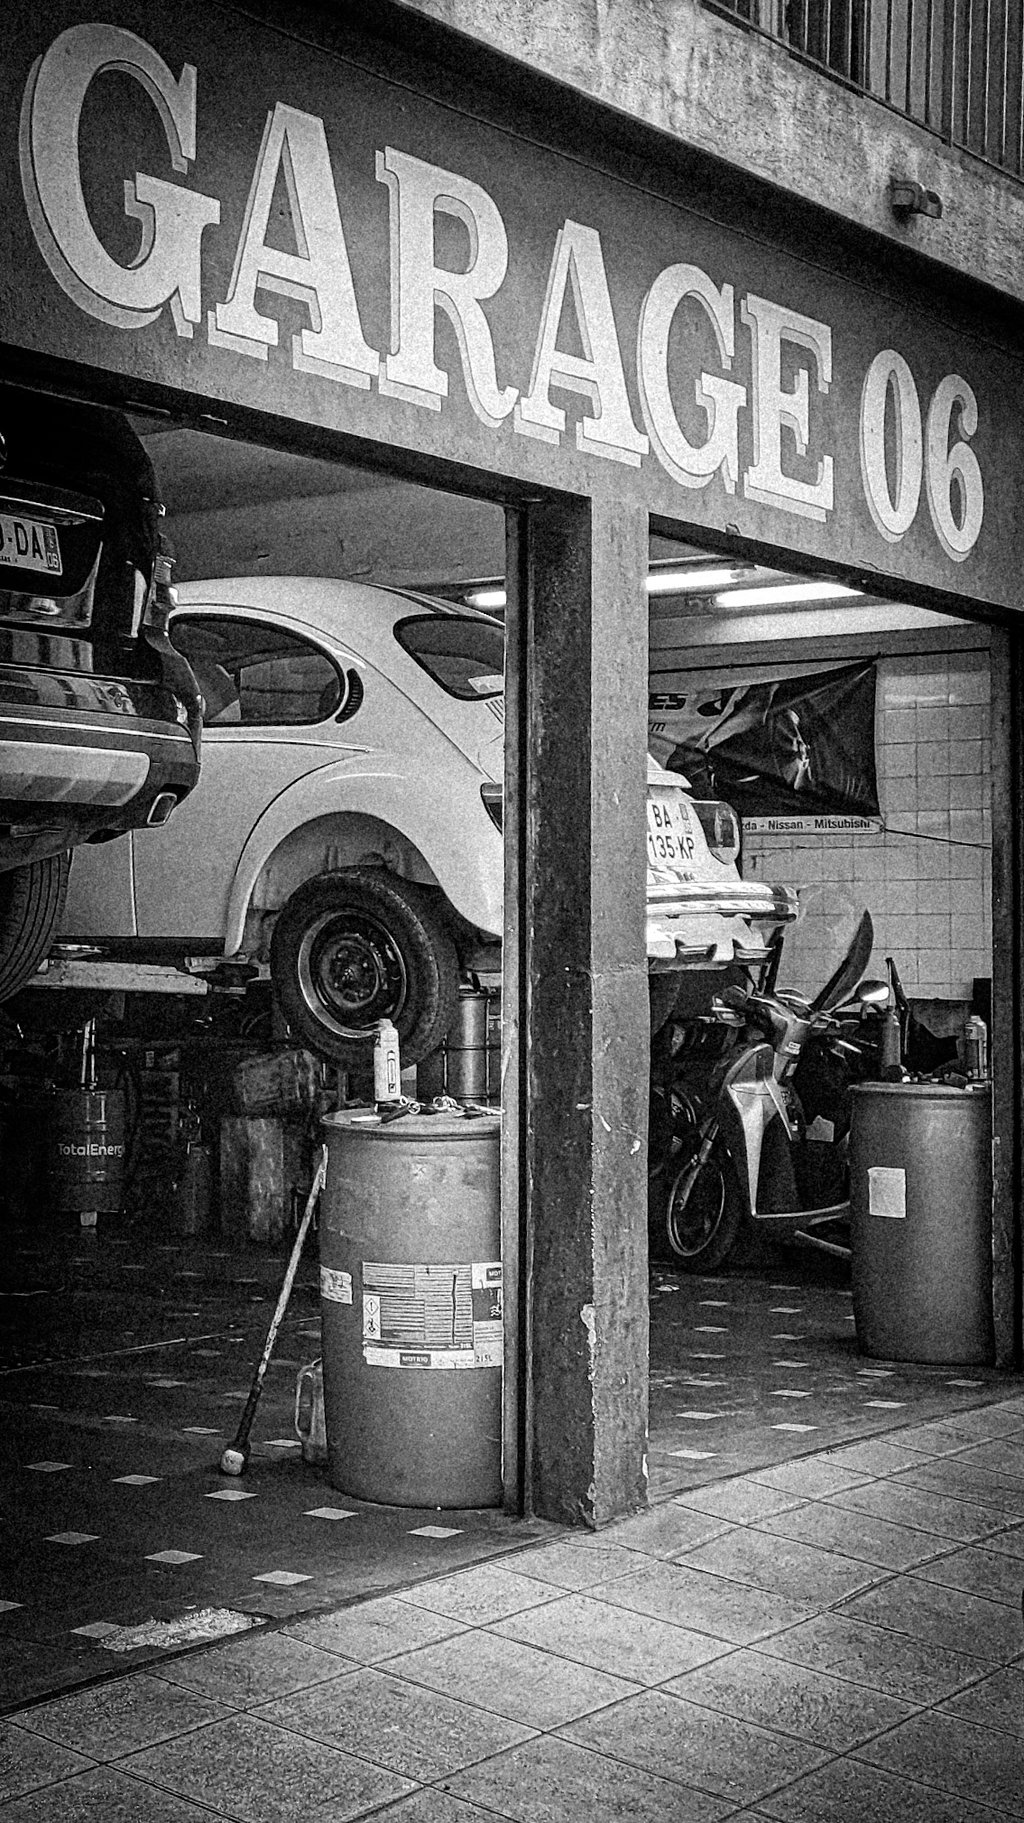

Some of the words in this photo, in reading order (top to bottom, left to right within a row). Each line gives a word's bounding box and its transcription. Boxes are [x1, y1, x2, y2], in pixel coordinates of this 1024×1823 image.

[19, 22, 835, 523] GARAGE
[859, 348, 984, 562] 06
[768, 819, 803, 830] Nissan
[814, 818, 870, 829] Mitsubishi
